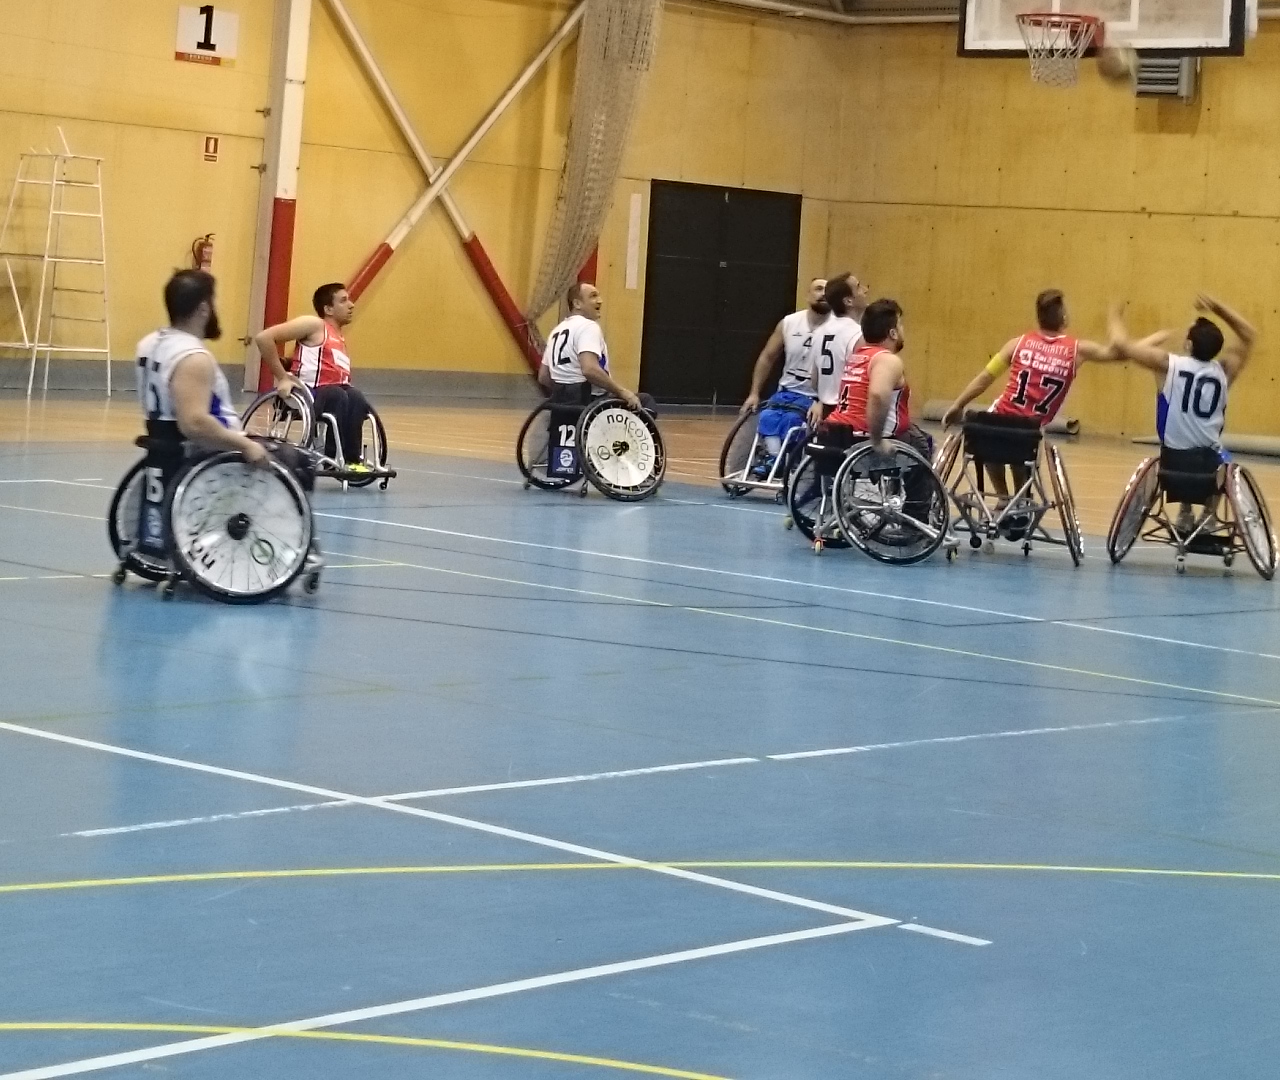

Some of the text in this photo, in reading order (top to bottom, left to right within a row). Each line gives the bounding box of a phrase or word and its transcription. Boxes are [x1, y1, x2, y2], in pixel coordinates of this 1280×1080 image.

[196, 4, 217, 52] 1
[551, 328, 571, 367] 12
[821, 334, 836, 375] 5
[1010, 369, 1066, 415] 17
[1177, 370, 1222, 419] 10
[558, 424, 577, 447] 12
